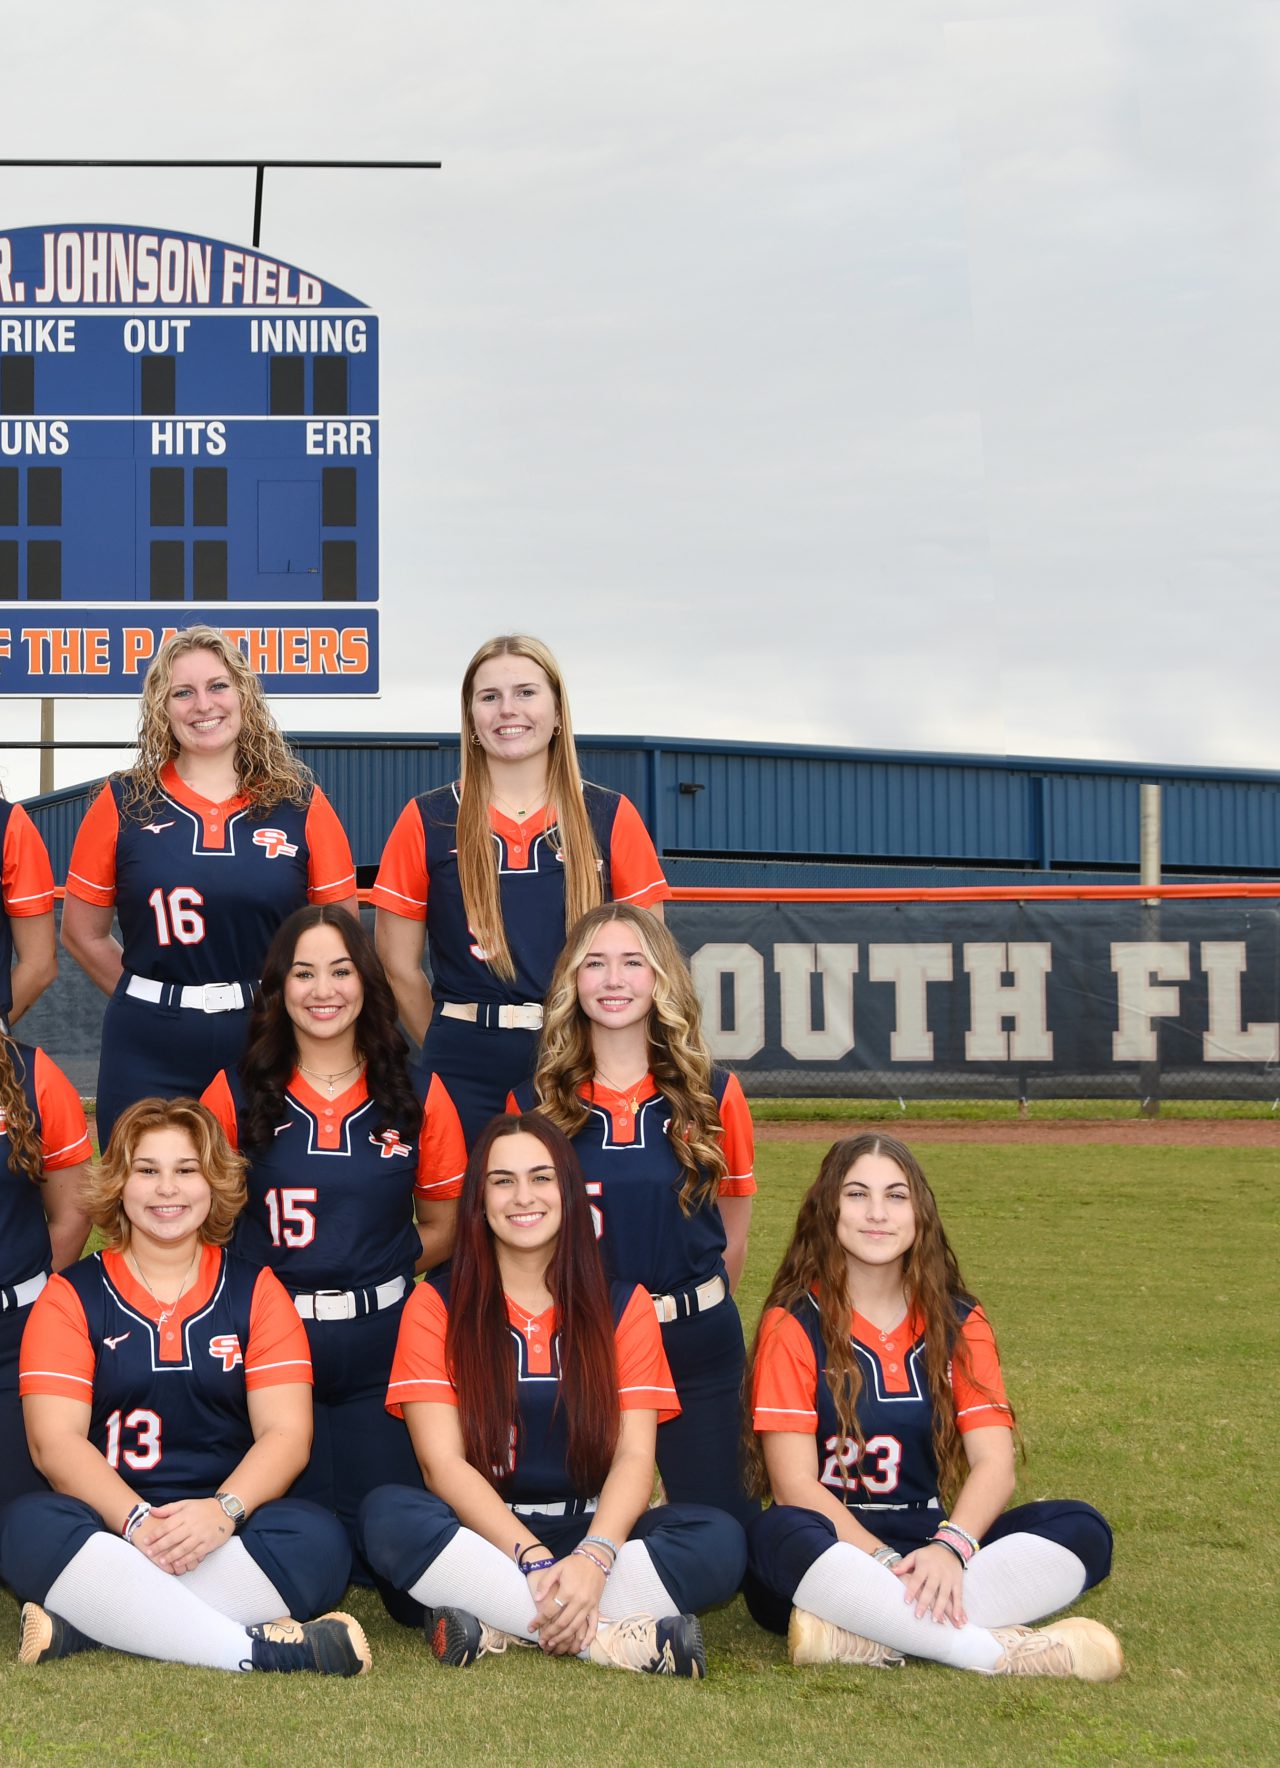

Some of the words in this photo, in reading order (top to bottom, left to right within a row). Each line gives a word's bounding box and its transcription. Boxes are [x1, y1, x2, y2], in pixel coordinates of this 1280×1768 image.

[35, 231, 214, 304] JOHNSON
[221, 248, 322, 306] FIELD
[124, 319, 191, 354] OUT
[250, 319, 368, 354] INNING
[151, 421, 228, 456] HITS
[306, 422, 373, 456] ERR
[21, 628, 111, 675] THE
[122, 628, 369, 675] PHERS
[149, 887, 206, 946] 16
[264, 1187, 318, 1249] 15
[105, 1408, 162, 1470] 13
[820, 1434, 902, 1494] 23
